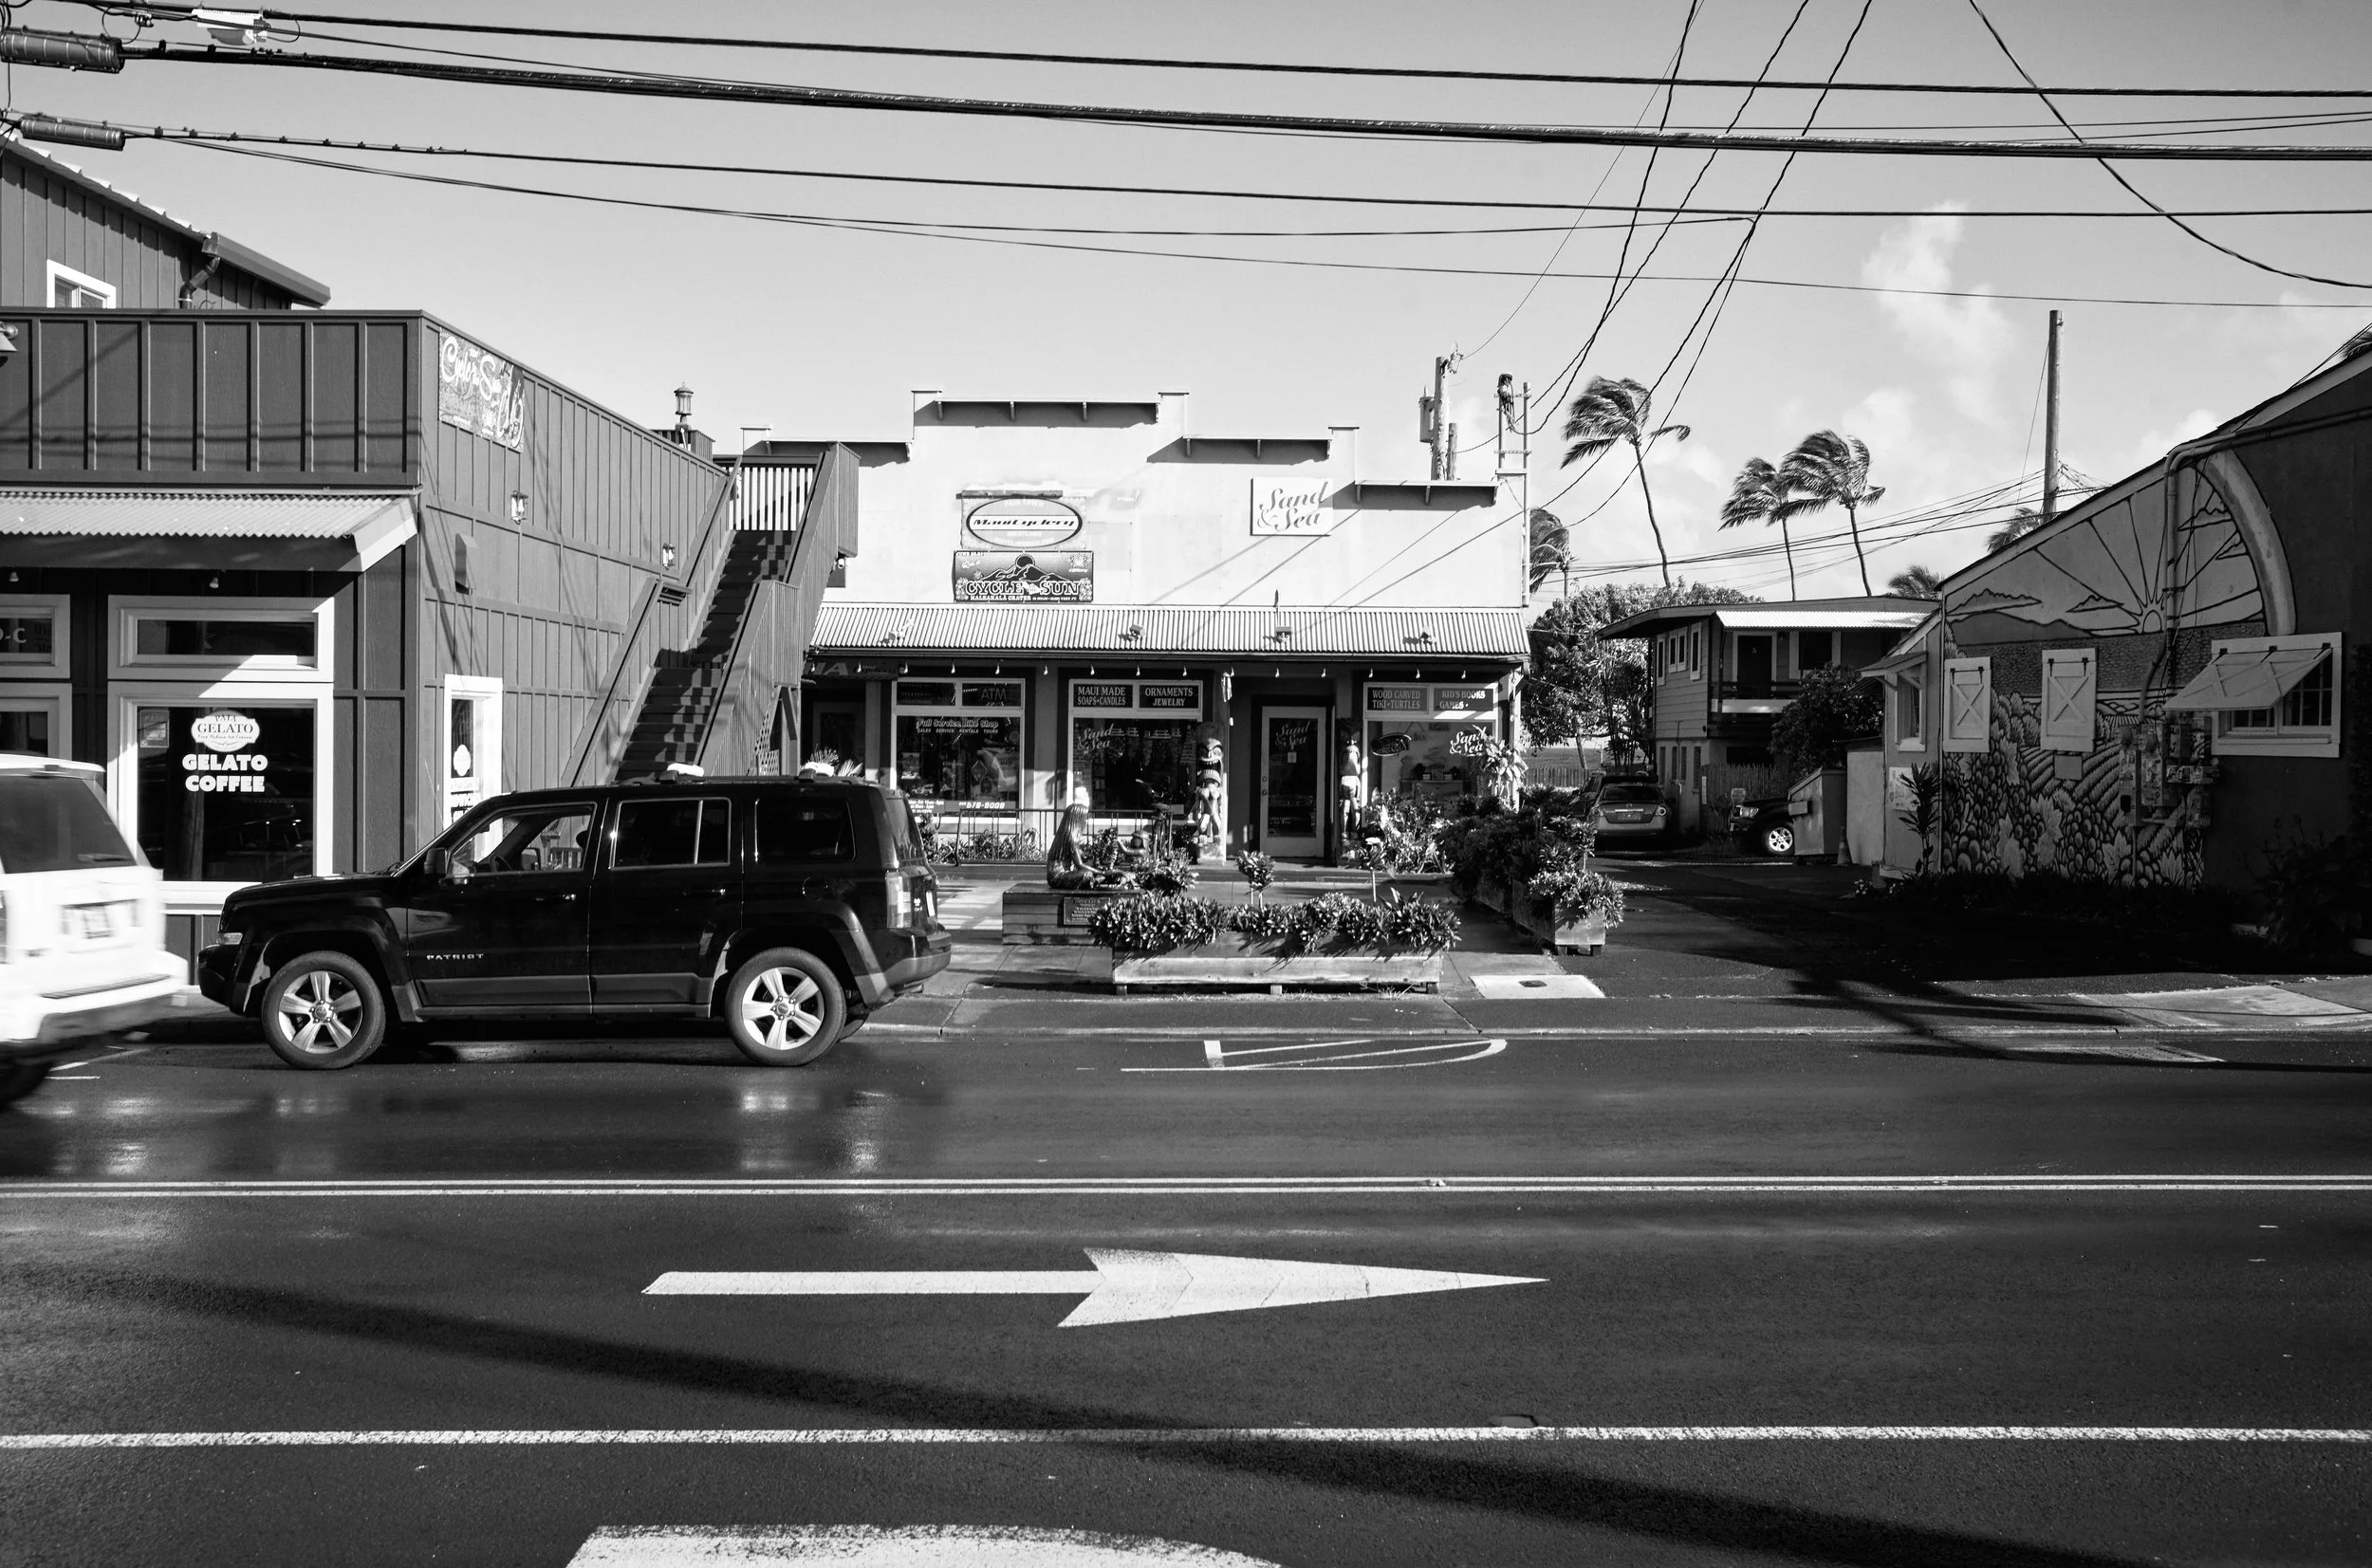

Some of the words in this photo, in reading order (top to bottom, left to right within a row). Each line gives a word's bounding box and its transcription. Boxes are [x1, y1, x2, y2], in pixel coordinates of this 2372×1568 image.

[1259, 482, 1328, 510] Sand
[1274, 508, 1320, 531] Sea
[966, 581, 1023, 596] CYCLE
[1040, 581, 1080, 596] SUN
[981, 688, 1006, 700] ATM
[1078, 687, 1099, 696] MAUI
[1102, 687, 1126, 696] MADE
[1145, 688, 1194, 697] ORNAMENTS
[1372, 691, 1392, 699] WOOD
[1394, 691, 1420, 699] CARVED
[1461, 691, 1486, 699] BOOKS
[1153, 698, 1185, 707] JEWELRY
[1439, 701, 1464, 710] GAMES
[197, 723, 253, 733] GELATO
[1084, 723, 1114, 740] Sand
[182, 753, 269, 771] GELATO
[185, 774, 266, 792] COFFEE
